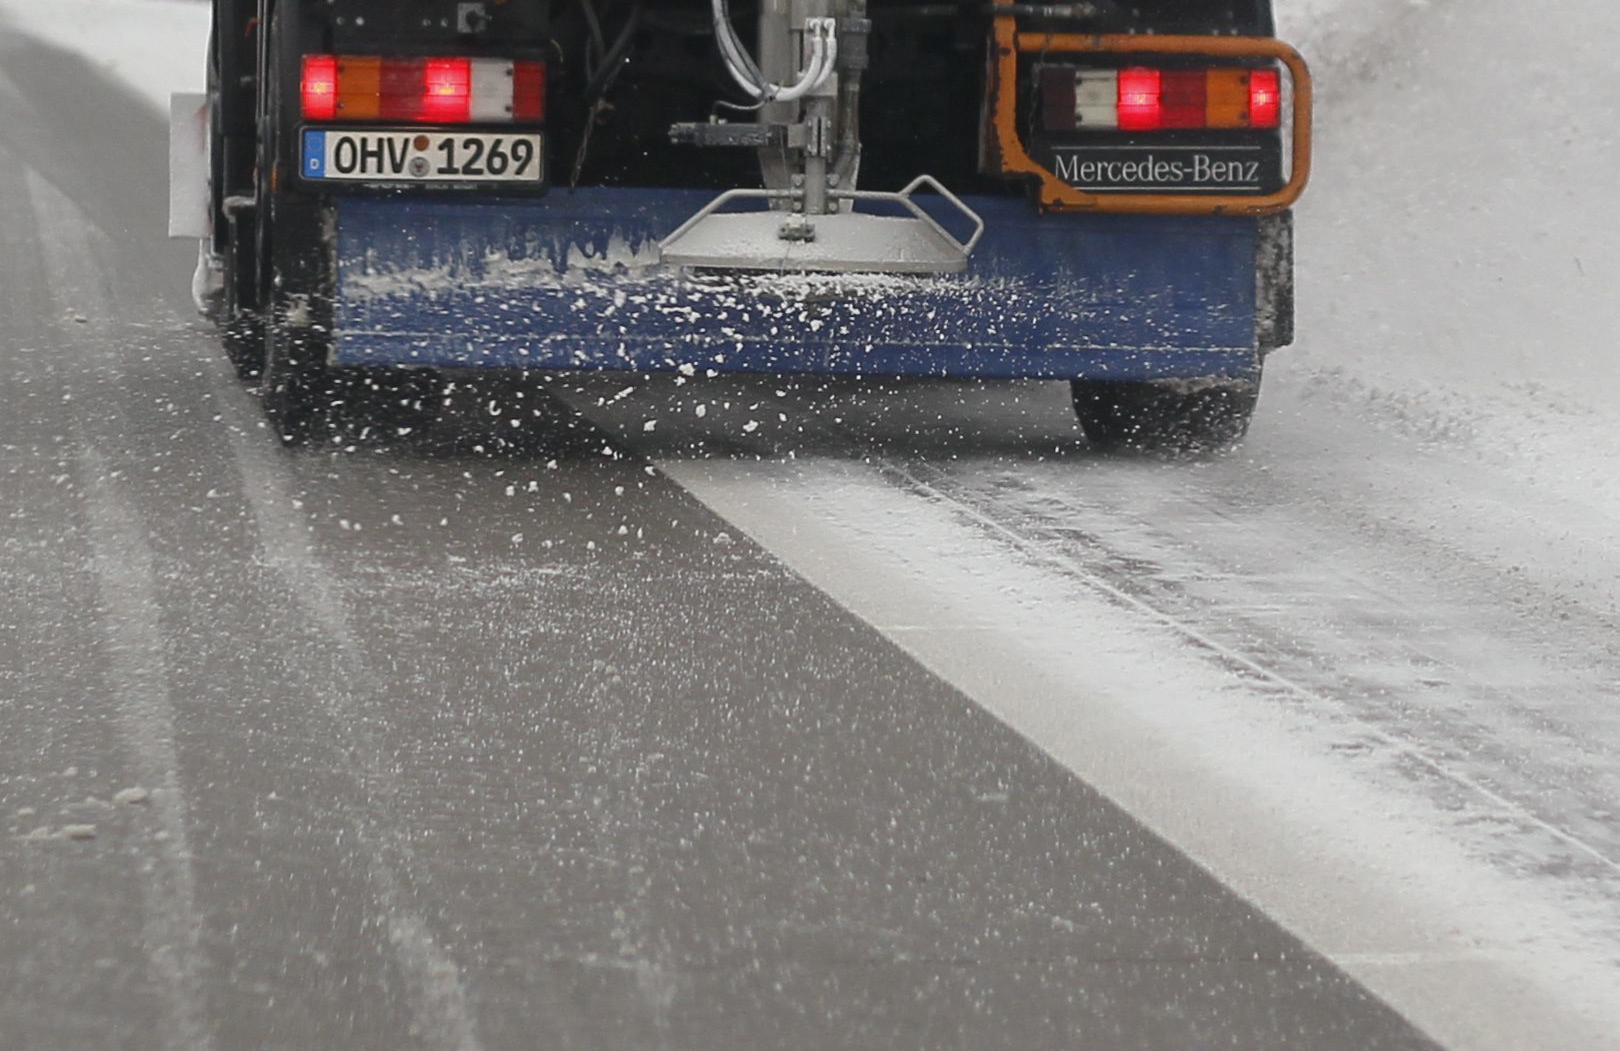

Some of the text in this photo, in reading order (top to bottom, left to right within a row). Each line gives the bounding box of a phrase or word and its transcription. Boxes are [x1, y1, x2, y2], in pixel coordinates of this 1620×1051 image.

[310, 136, 534, 176] D OHV 1269
[1054, 154, 1260, 183] Mercedes-Benz
